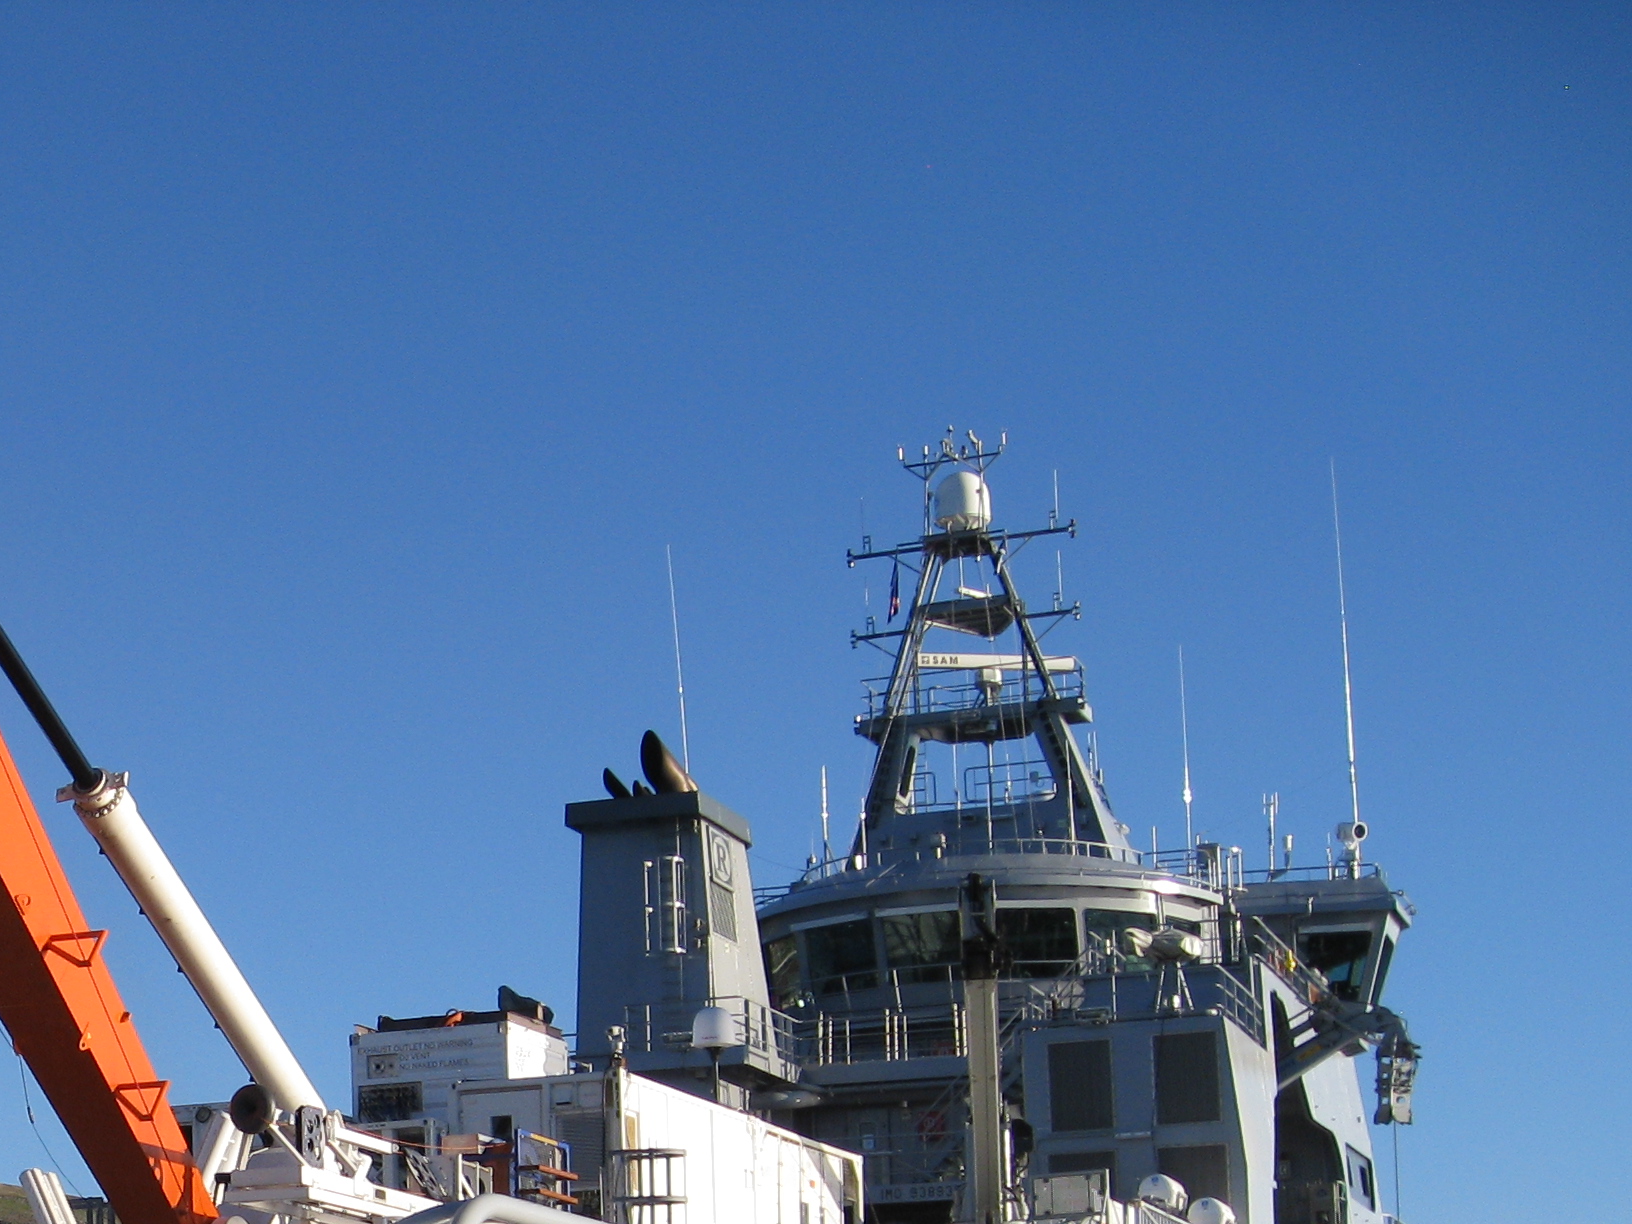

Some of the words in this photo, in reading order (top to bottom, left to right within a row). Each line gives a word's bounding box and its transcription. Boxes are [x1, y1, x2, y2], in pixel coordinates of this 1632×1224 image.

[932, 655, 959, 665] SAM
[716, 841, 729, 878] R
[358, 1045, 392, 1055] EXHAUST
[393, 1042, 423, 1053] OUTLET
[437, 1038, 473, 1049] WARNING
[410, 1052, 430, 1061] VENT
[411, 1061, 438, 1070] NAKED
[439, 1058, 469, 1068] FLAMES
[880, 1188, 902, 1200] IMO
